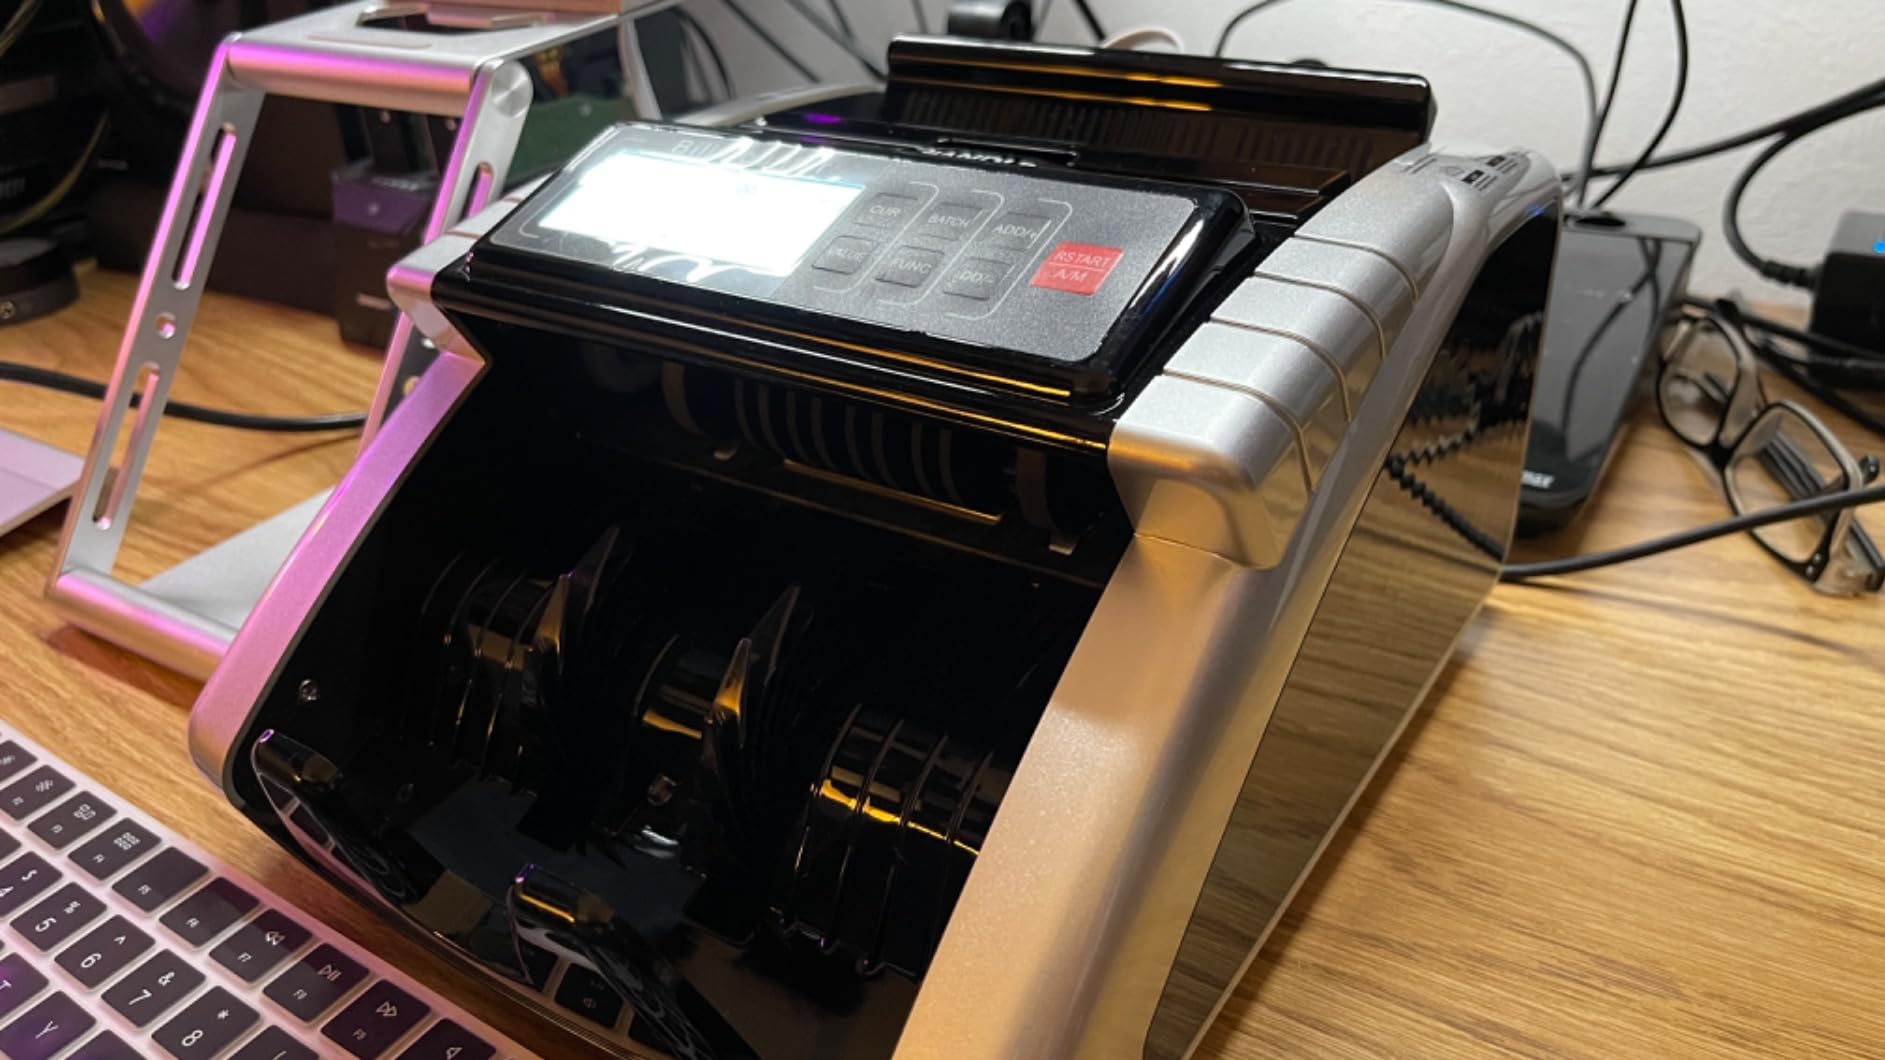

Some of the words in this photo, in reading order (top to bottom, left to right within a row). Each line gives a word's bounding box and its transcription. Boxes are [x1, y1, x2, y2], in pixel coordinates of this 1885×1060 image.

[869, 204, 901, 217] CUR
[928, 213, 971, 228] BATCH
[1054, 251, 1111, 268] RSTART
[1054, 269, 1088, 281] A/M
[35, 917, 57, 933] 5
[80, 953, 102, 968] 6
[158, 971, 175, 987] &
[128, 988, 152, 1006] 7
[35, 1020, 59, 1040] Y
[181, 1029, 204, 1047] 8
